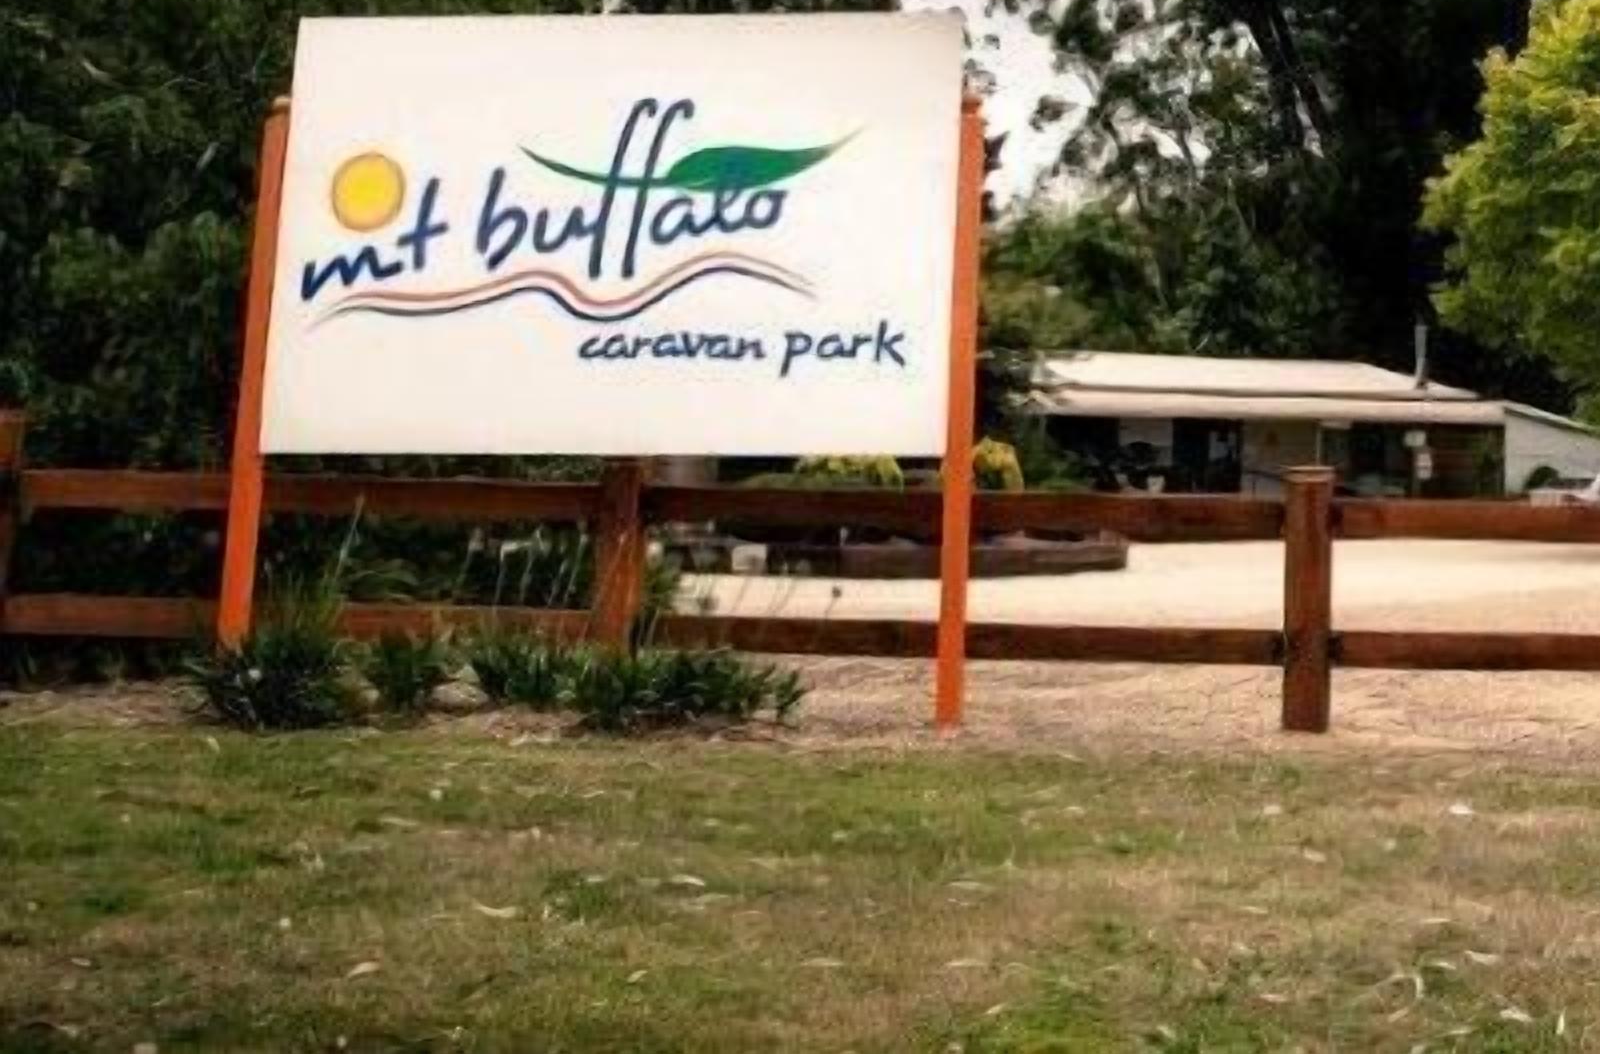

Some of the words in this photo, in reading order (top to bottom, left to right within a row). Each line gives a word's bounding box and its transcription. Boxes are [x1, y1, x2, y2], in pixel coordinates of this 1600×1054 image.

[301, 177, 448, 300] mt
[475, 98, 789, 279] buffalo
[577, 329, 766, 361] caravan
[779, 320, 906, 376] park
